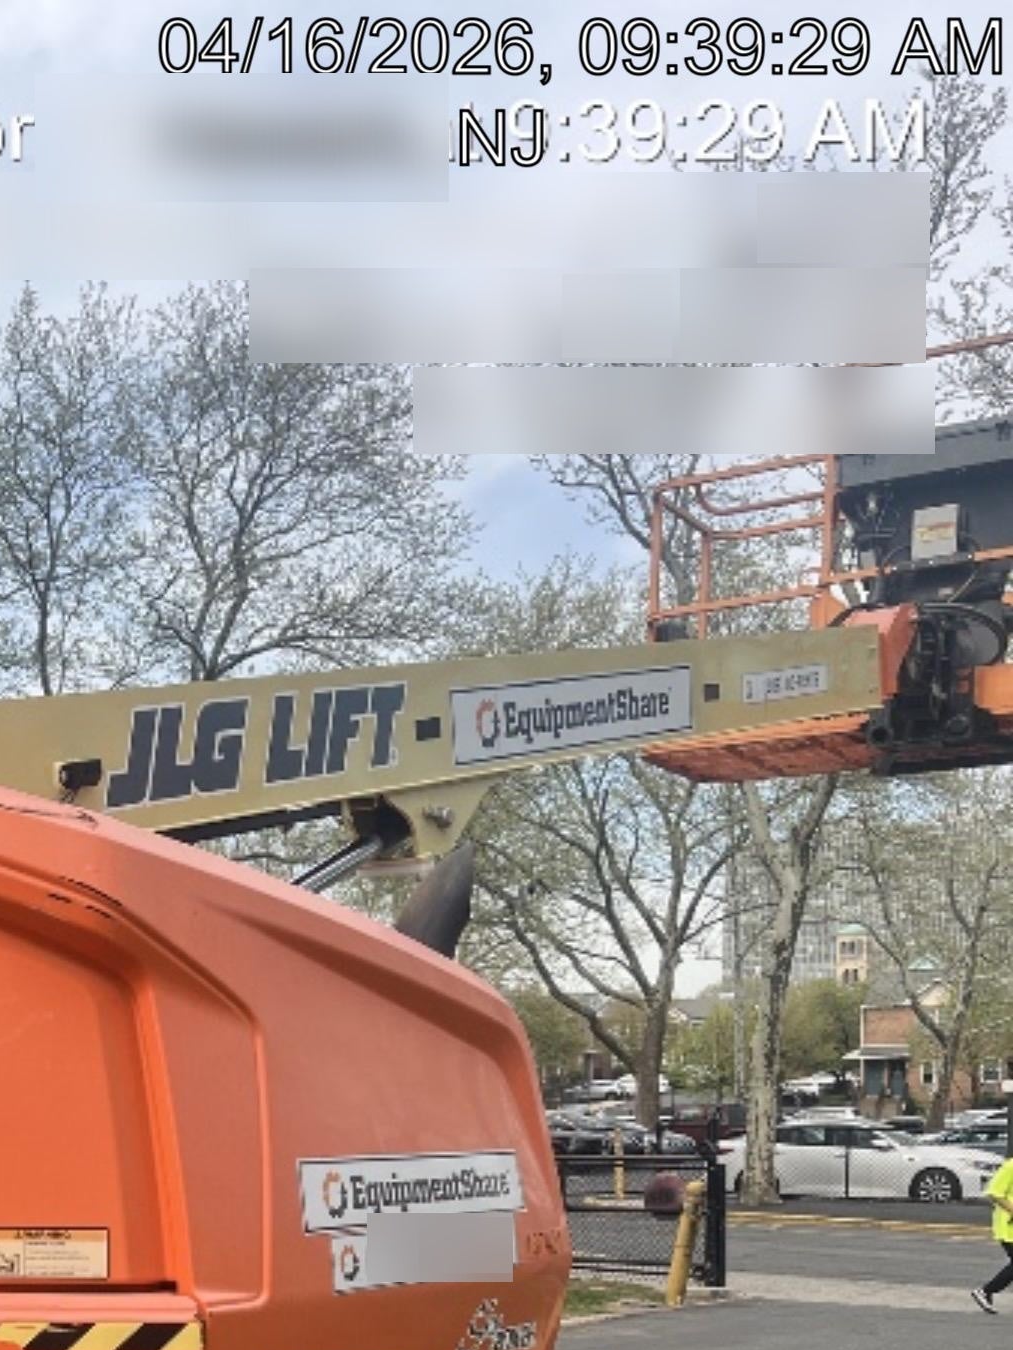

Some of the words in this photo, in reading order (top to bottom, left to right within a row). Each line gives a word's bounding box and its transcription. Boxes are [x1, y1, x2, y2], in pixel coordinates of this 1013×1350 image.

[502, 687, 671, 744] EquipmentShare
[104, 696, 251, 811] JLG
[263, 680, 407, 787] LIFT
[349, 1166, 511, 1214] EquipmentShare
